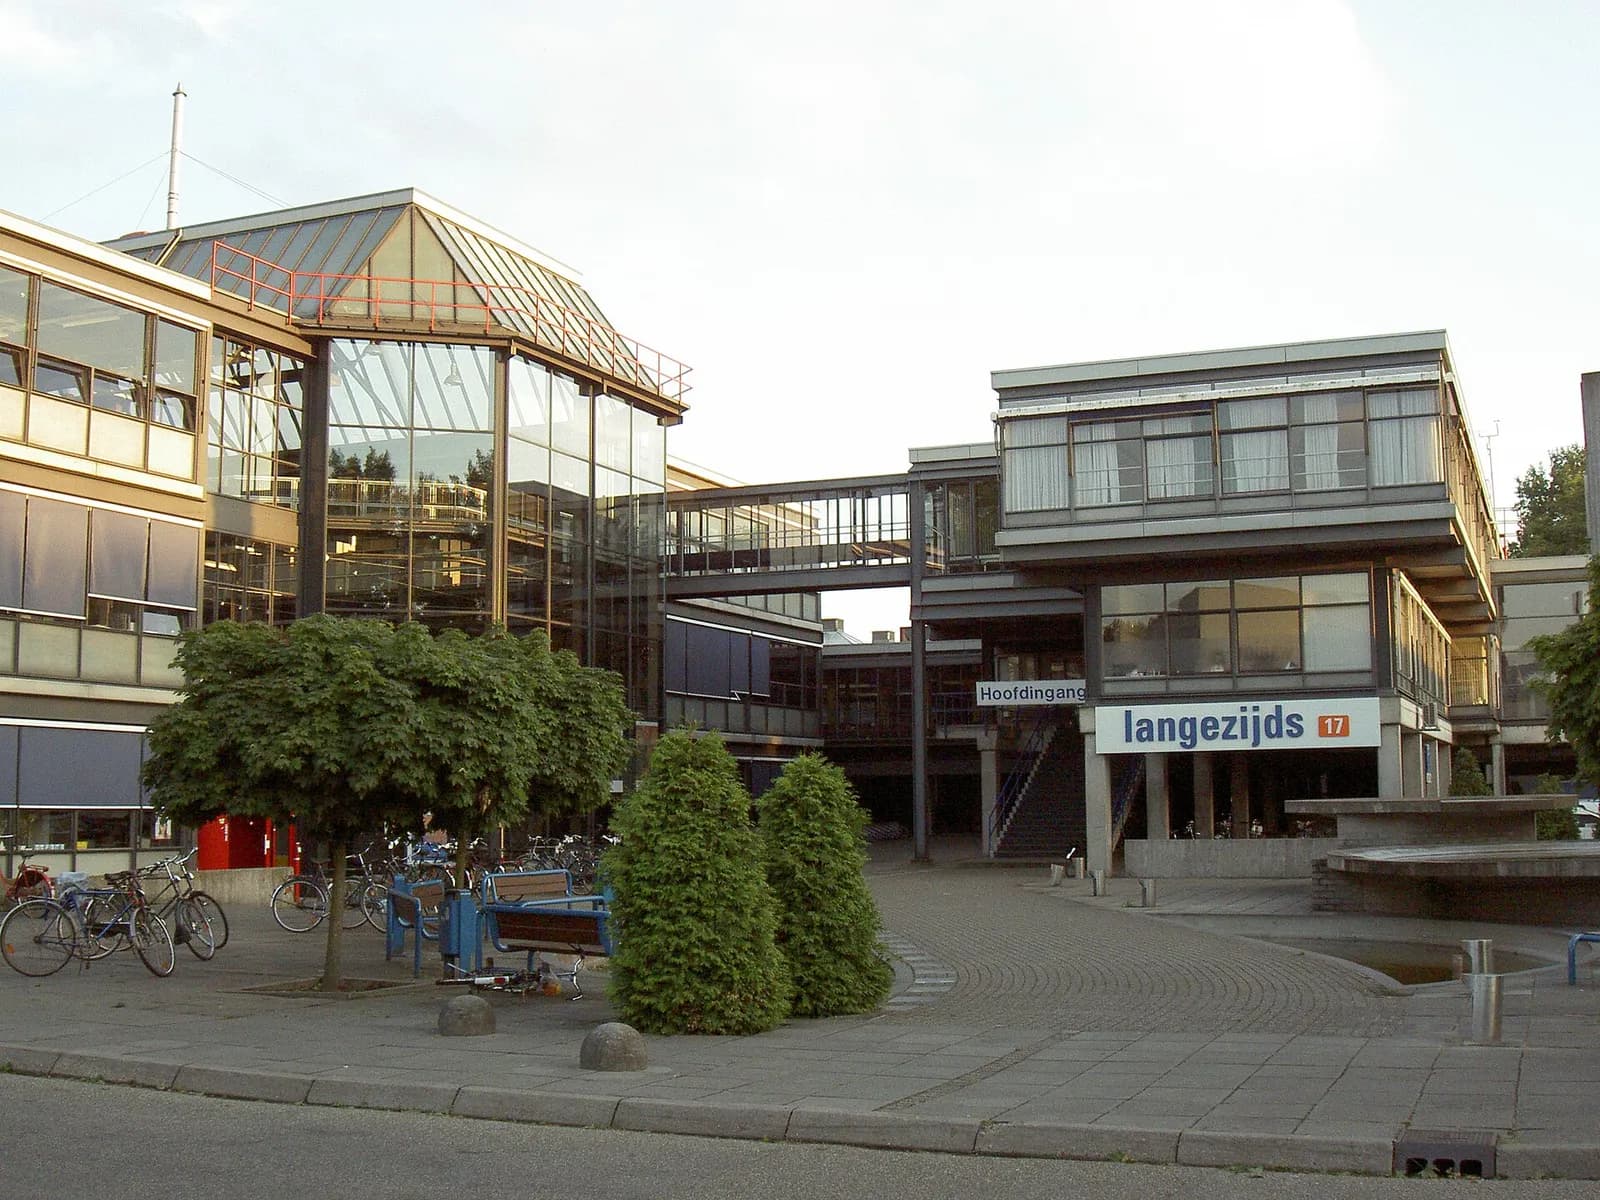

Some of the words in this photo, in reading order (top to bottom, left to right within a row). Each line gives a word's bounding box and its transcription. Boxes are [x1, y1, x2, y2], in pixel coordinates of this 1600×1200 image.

[980, 686, 1086, 702] Hoofdingang
[1124, 704, 1304, 750] langezijds
[1324, 717, 1344, 735] 17
